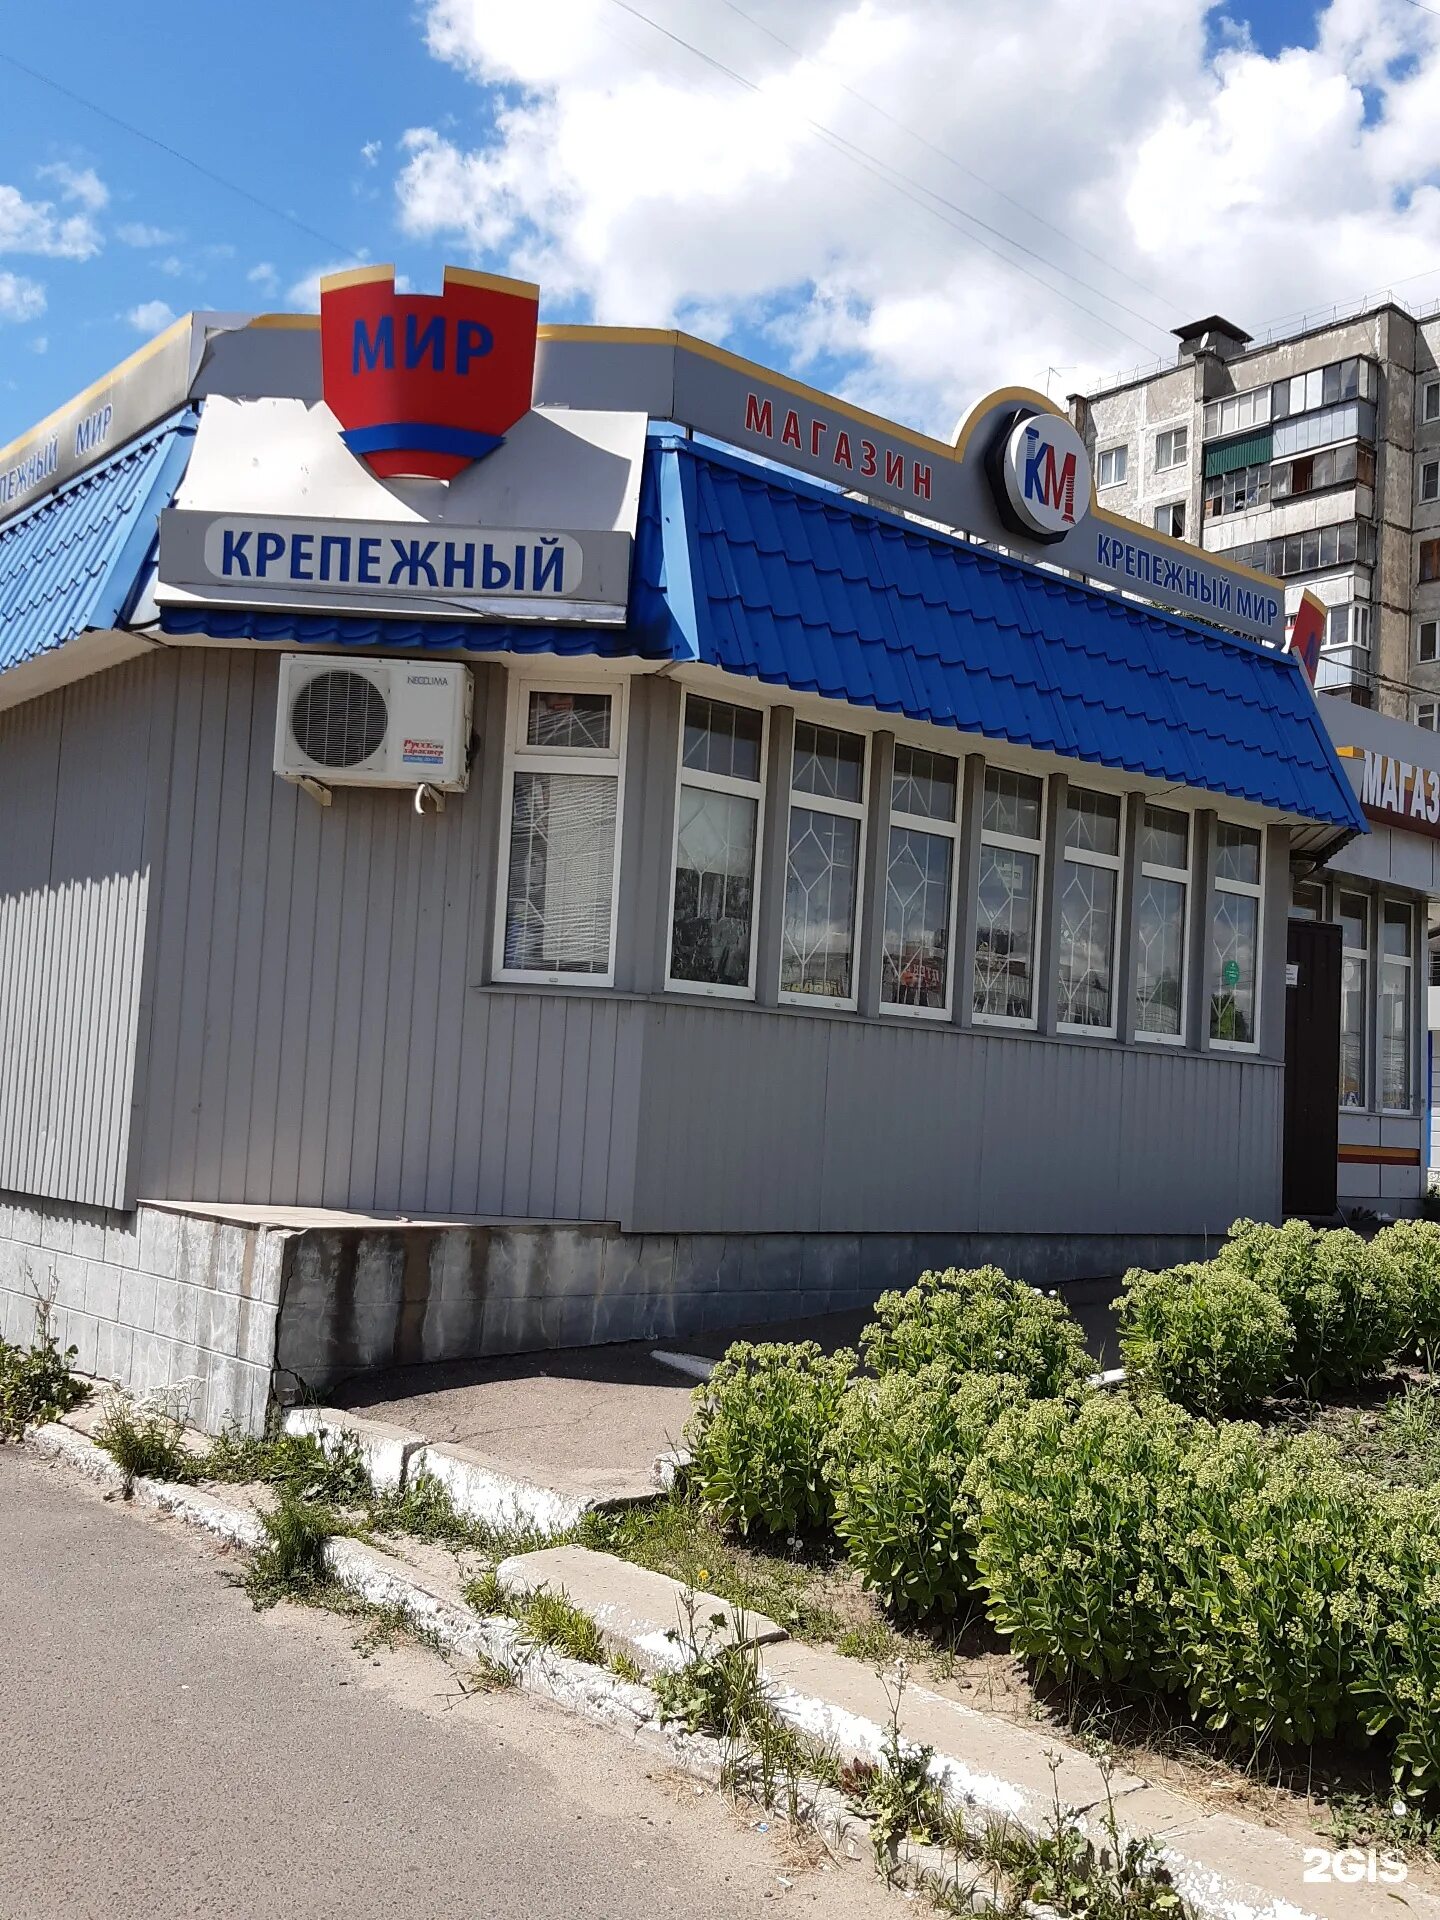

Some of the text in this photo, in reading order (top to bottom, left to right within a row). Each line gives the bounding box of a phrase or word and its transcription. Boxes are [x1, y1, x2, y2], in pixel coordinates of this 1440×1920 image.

[352, 314, 494, 376] МИР
[74, 403, 113, 458] МИР
[745, 392, 932, 501] МАГАЗИН
[222, 530, 565, 593] КРЕПЕЖНЫЙ
[1097, 532, 1278, 627] КРЕПЕЖНЫЙ МИР
[407, 676, 448, 686] NEOCLIMA
[1361, 750, 1440, 825] МАГАЗ
